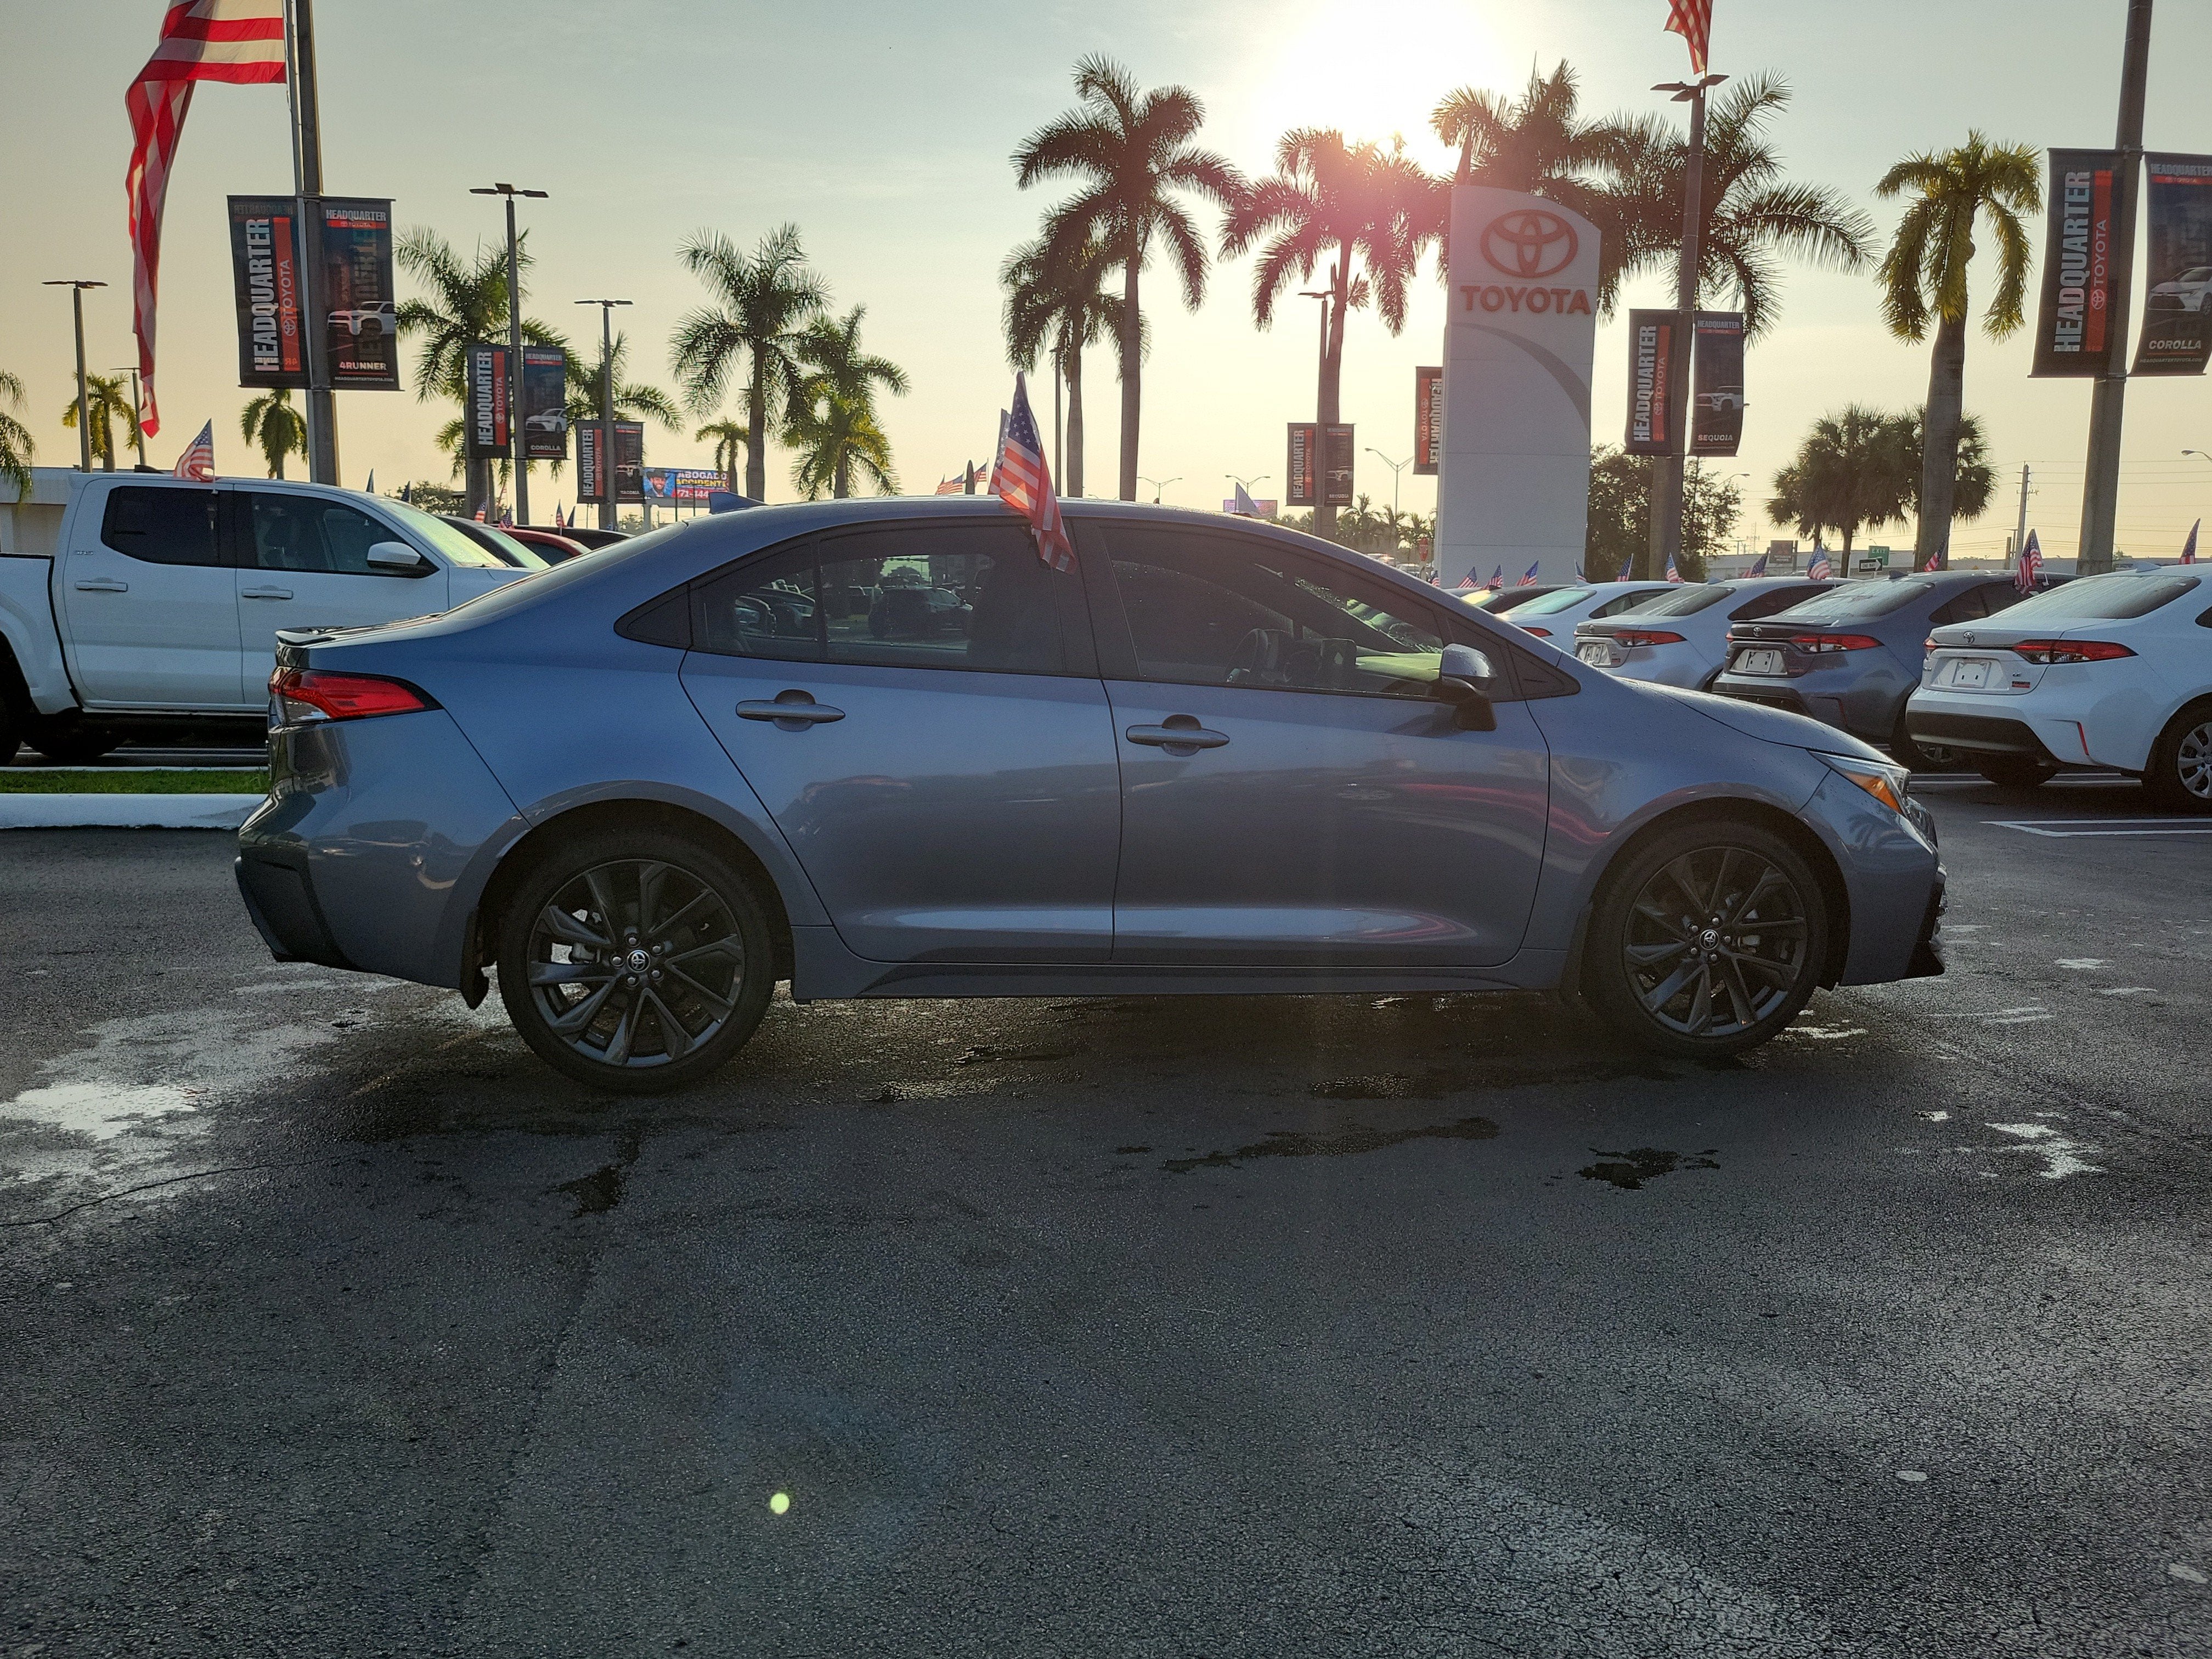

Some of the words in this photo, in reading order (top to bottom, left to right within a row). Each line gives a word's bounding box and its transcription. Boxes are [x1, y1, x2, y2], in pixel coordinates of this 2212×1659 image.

[326, 209, 386, 221] HEADQUARTER
[2053, 171, 2090, 352] HEADQUARTER
[2092, 219, 2107, 286] TOYOTA
[246, 219, 279, 371] HEADQUARTER
[279, 259, 294, 316] TOYOTA
[1460, 285, 1591, 314] TOYOTA
[1697, 320, 1739, 329] HEADQUARTER
[2149, 340, 2202, 349] COROLLA
[339, 362, 387, 370] 4RUNNER
[1633, 325, 1656, 442] HEADQUARTER
[1655, 357, 1665, 400] TOYOTA
[477, 352, 494, 445] HEADQUARTER
[583, 430, 595, 496] HEADQUARTER
[1293, 430, 1305, 498] HEADQUARTER
